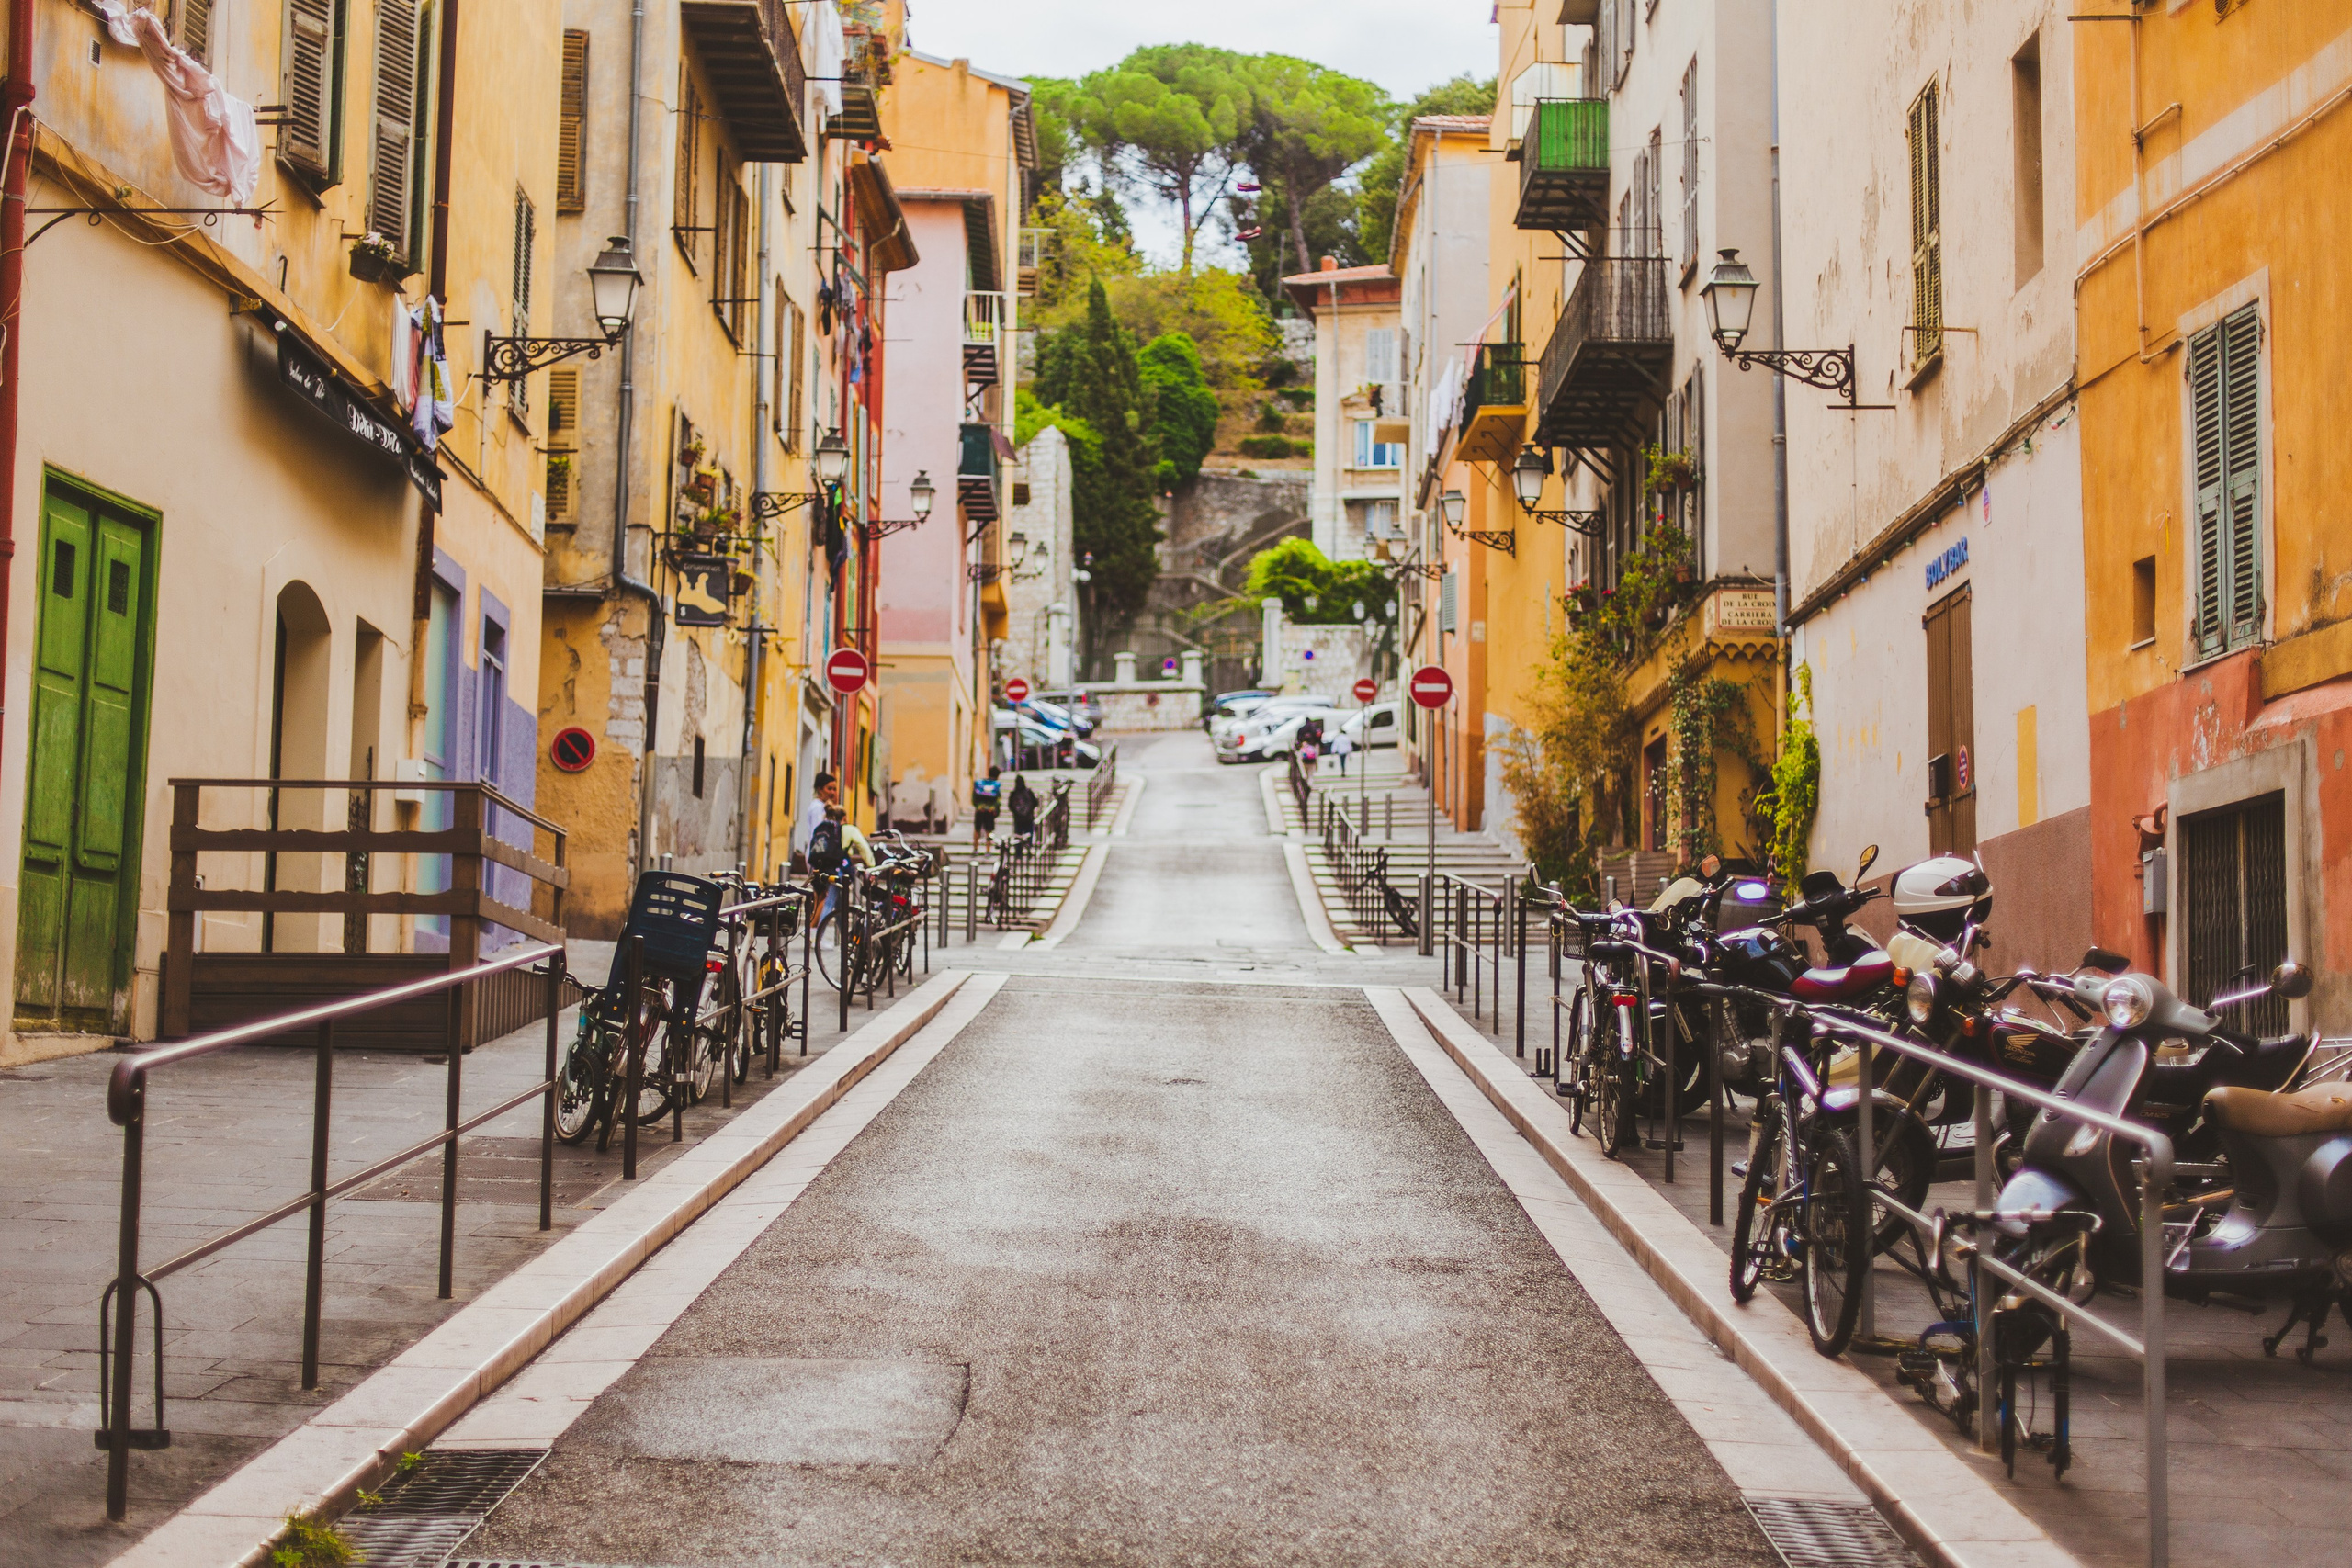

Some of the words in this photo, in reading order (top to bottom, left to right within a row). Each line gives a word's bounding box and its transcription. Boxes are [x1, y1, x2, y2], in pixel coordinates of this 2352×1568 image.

[1925, 536, 1969, 590] BOLYBAR
[2005, 1044, 2036, 1057] HONDA
[2004, 1052, 2035, 1066] Custom
